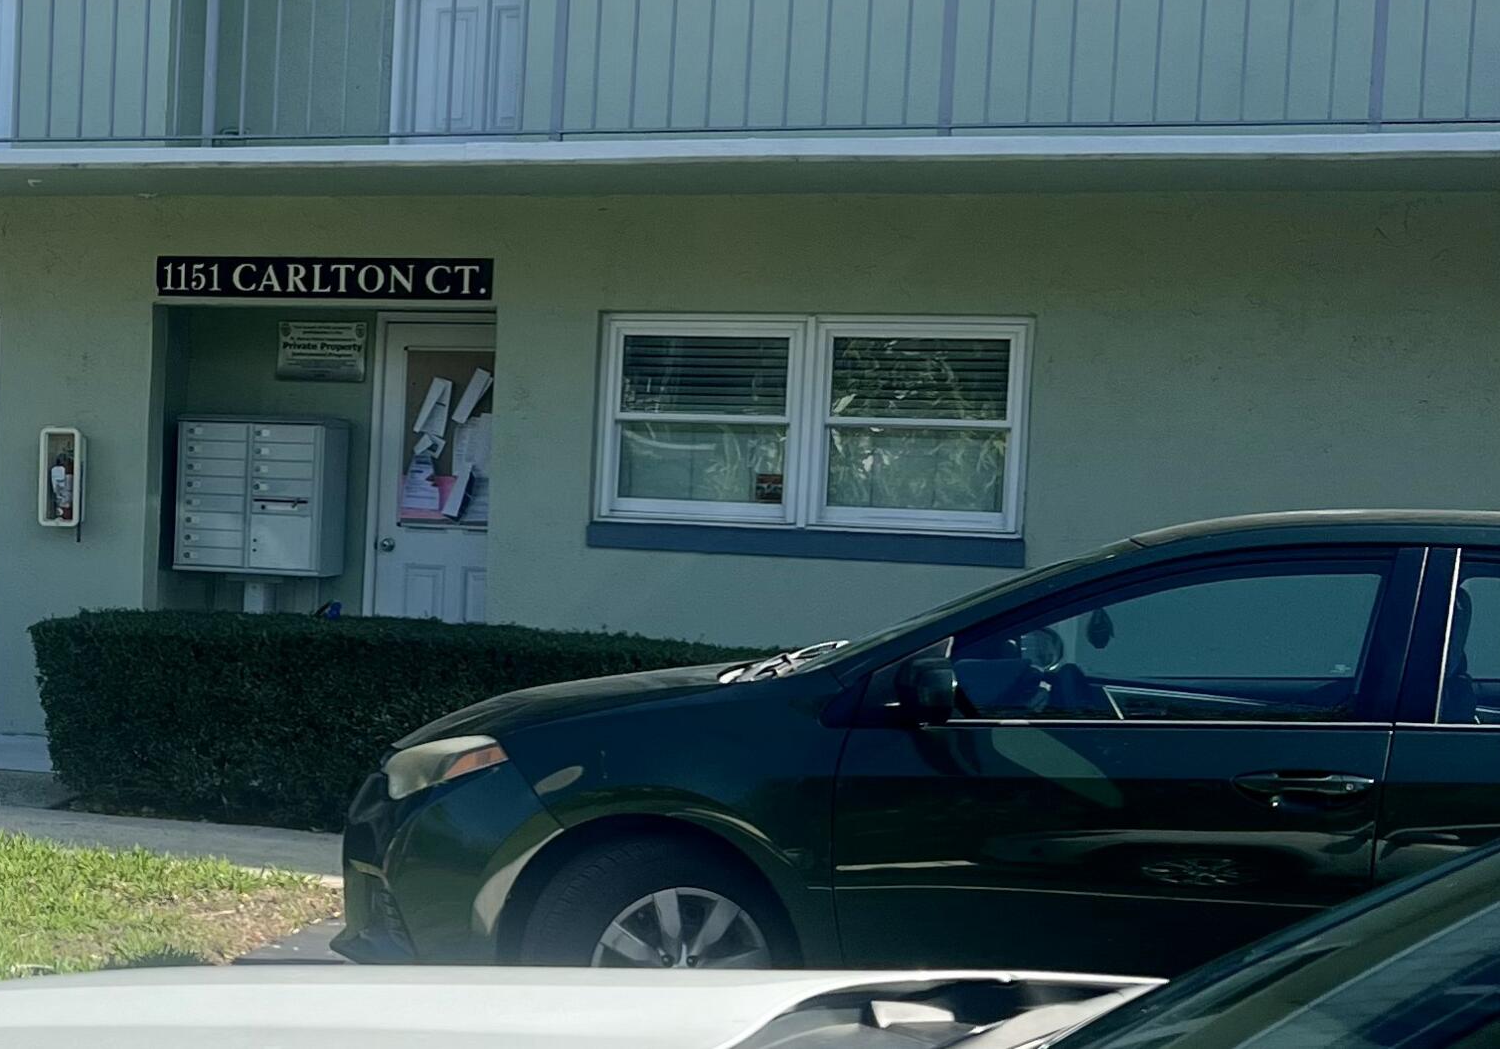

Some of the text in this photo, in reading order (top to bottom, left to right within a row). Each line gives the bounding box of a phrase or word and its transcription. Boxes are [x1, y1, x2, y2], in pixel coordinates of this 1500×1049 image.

[162, 262, 487, 295] 1151 CARLTON CT.
[282, 341, 362, 352] Private Property
